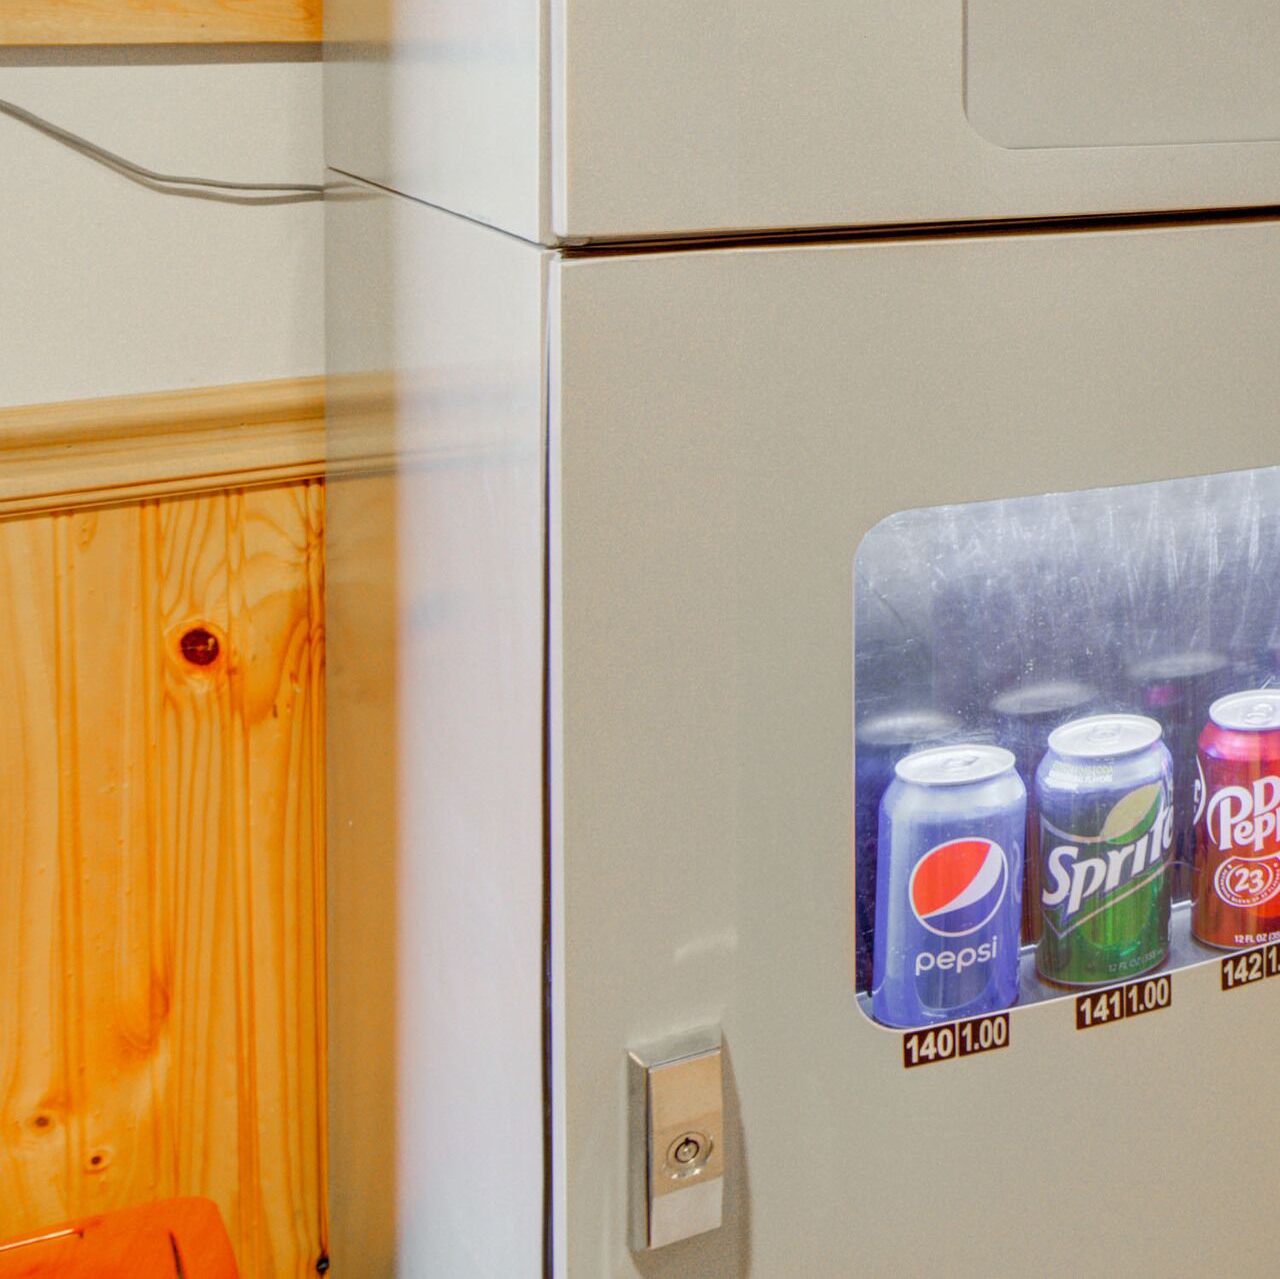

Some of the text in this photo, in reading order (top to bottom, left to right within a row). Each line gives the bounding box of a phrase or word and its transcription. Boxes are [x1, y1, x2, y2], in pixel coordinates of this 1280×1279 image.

[1235, 868, 1264, 893] 23
[915, 935, 997, 976] pepsi
[1234, 933, 1244, 944] 12
[1245, 932, 1255, 943] FL
[1255, 931, 1267, 942] OZ
[1223, 953, 1263, 987] 142
[1080, 978, 1169, 1024] 141 1.00
[905, 1020, 1007, 1064] 140 1.00
